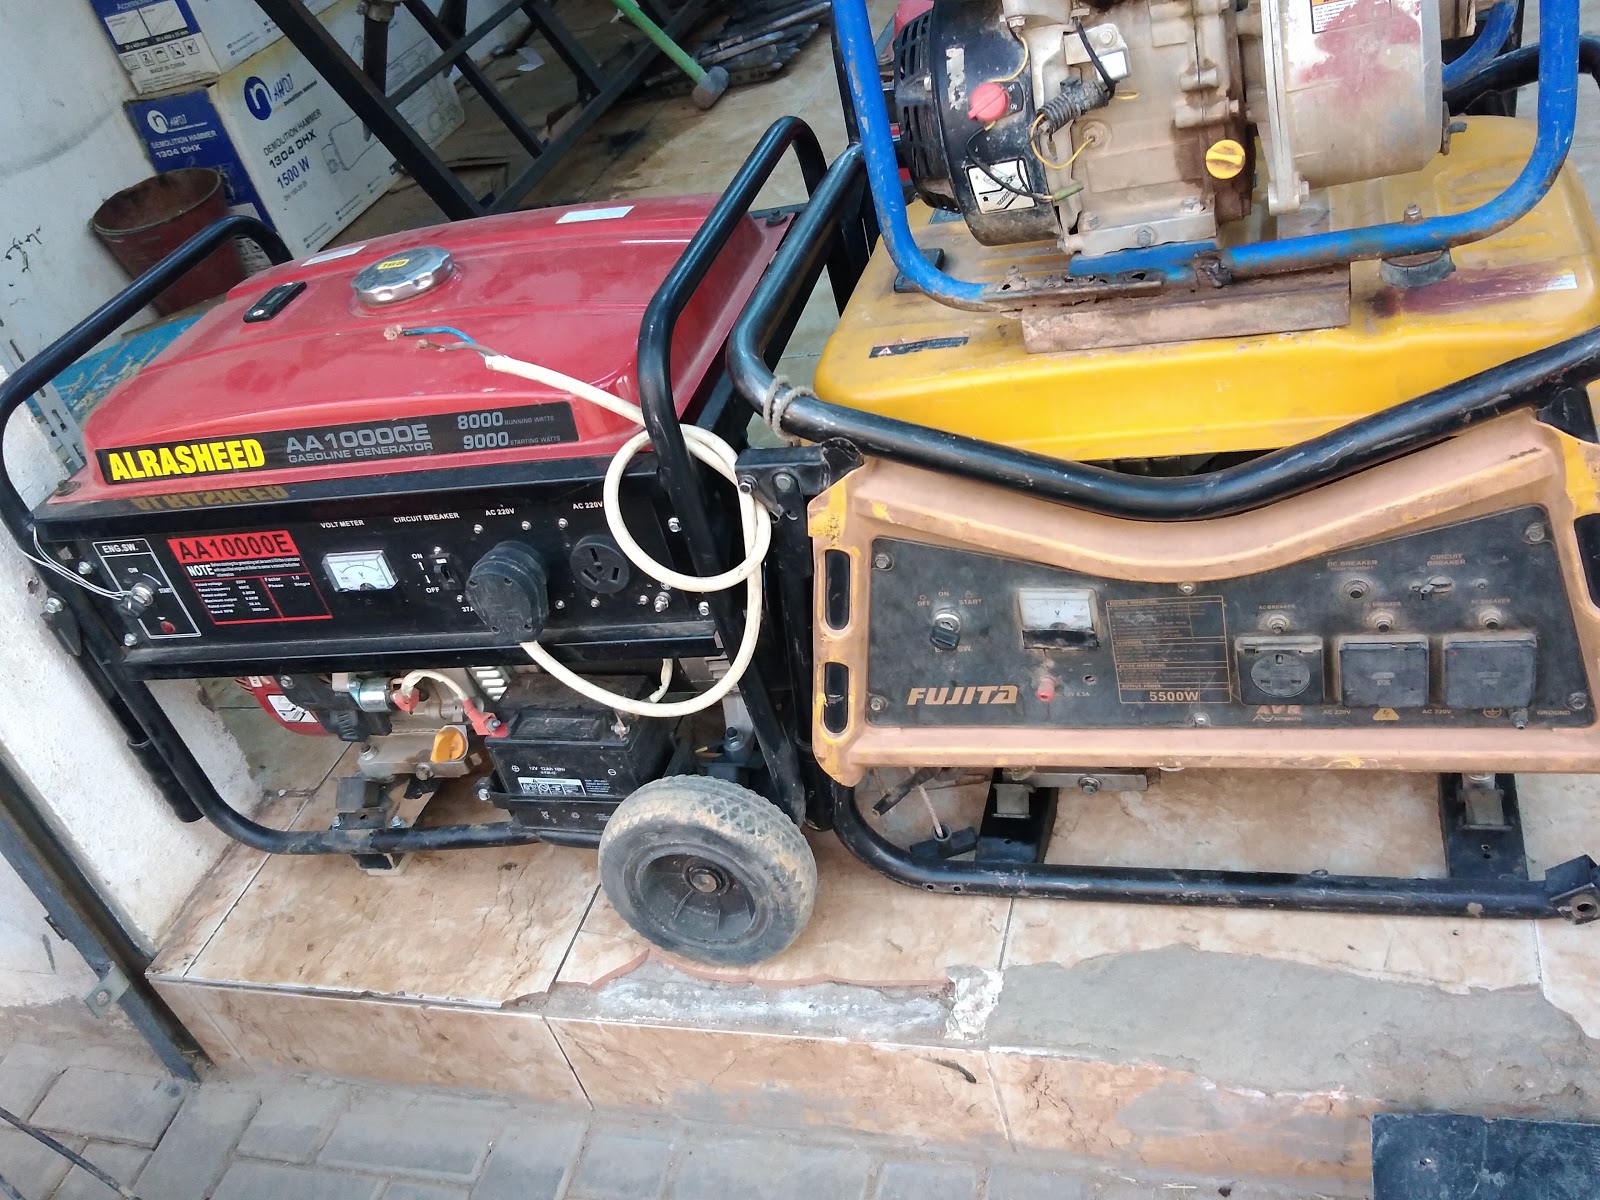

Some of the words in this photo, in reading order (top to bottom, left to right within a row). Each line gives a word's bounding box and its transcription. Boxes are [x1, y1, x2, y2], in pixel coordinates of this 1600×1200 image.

[151, 136, 189, 149] DEMOLITION
[188, 130, 218, 142] HAMMER
[263, 124, 299, 156] DEMOLITION
[298, 108, 322, 131] HAMMER
[156, 148, 180, 158] 1304
[181, 144, 202, 154] DHX
[269, 146, 295, 168] 1304
[296, 129, 317, 150] DHX
[277, 165, 300, 188] 1500
[300, 156, 310, 172] W
[457, 412, 504, 430] 8000
[504, 416, 533, 425] RUNNING
[286, 424, 431, 454] AA10000E
[463, 432, 509, 450] 9000
[510, 436, 540, 446] STARTING
[540, 434, 561, 443] WATTS
[108, 438, 266, 481] ALRASHEED
[288, 450, 352, 464] GASOLINE
[353, 441, 434, 457] GENERATOR
[424, 512, 460, 520] BREAKER
[102, 544, 139, 554] ENG.SW.
[179, 534, 292, 560] AA10000E
[186, 564, 216, 577] NOTE
[958, 598, 983, 606] START
[906, 685, 1018, 706] FUJITA
[1150, 691, 1199, 701] 5500W
